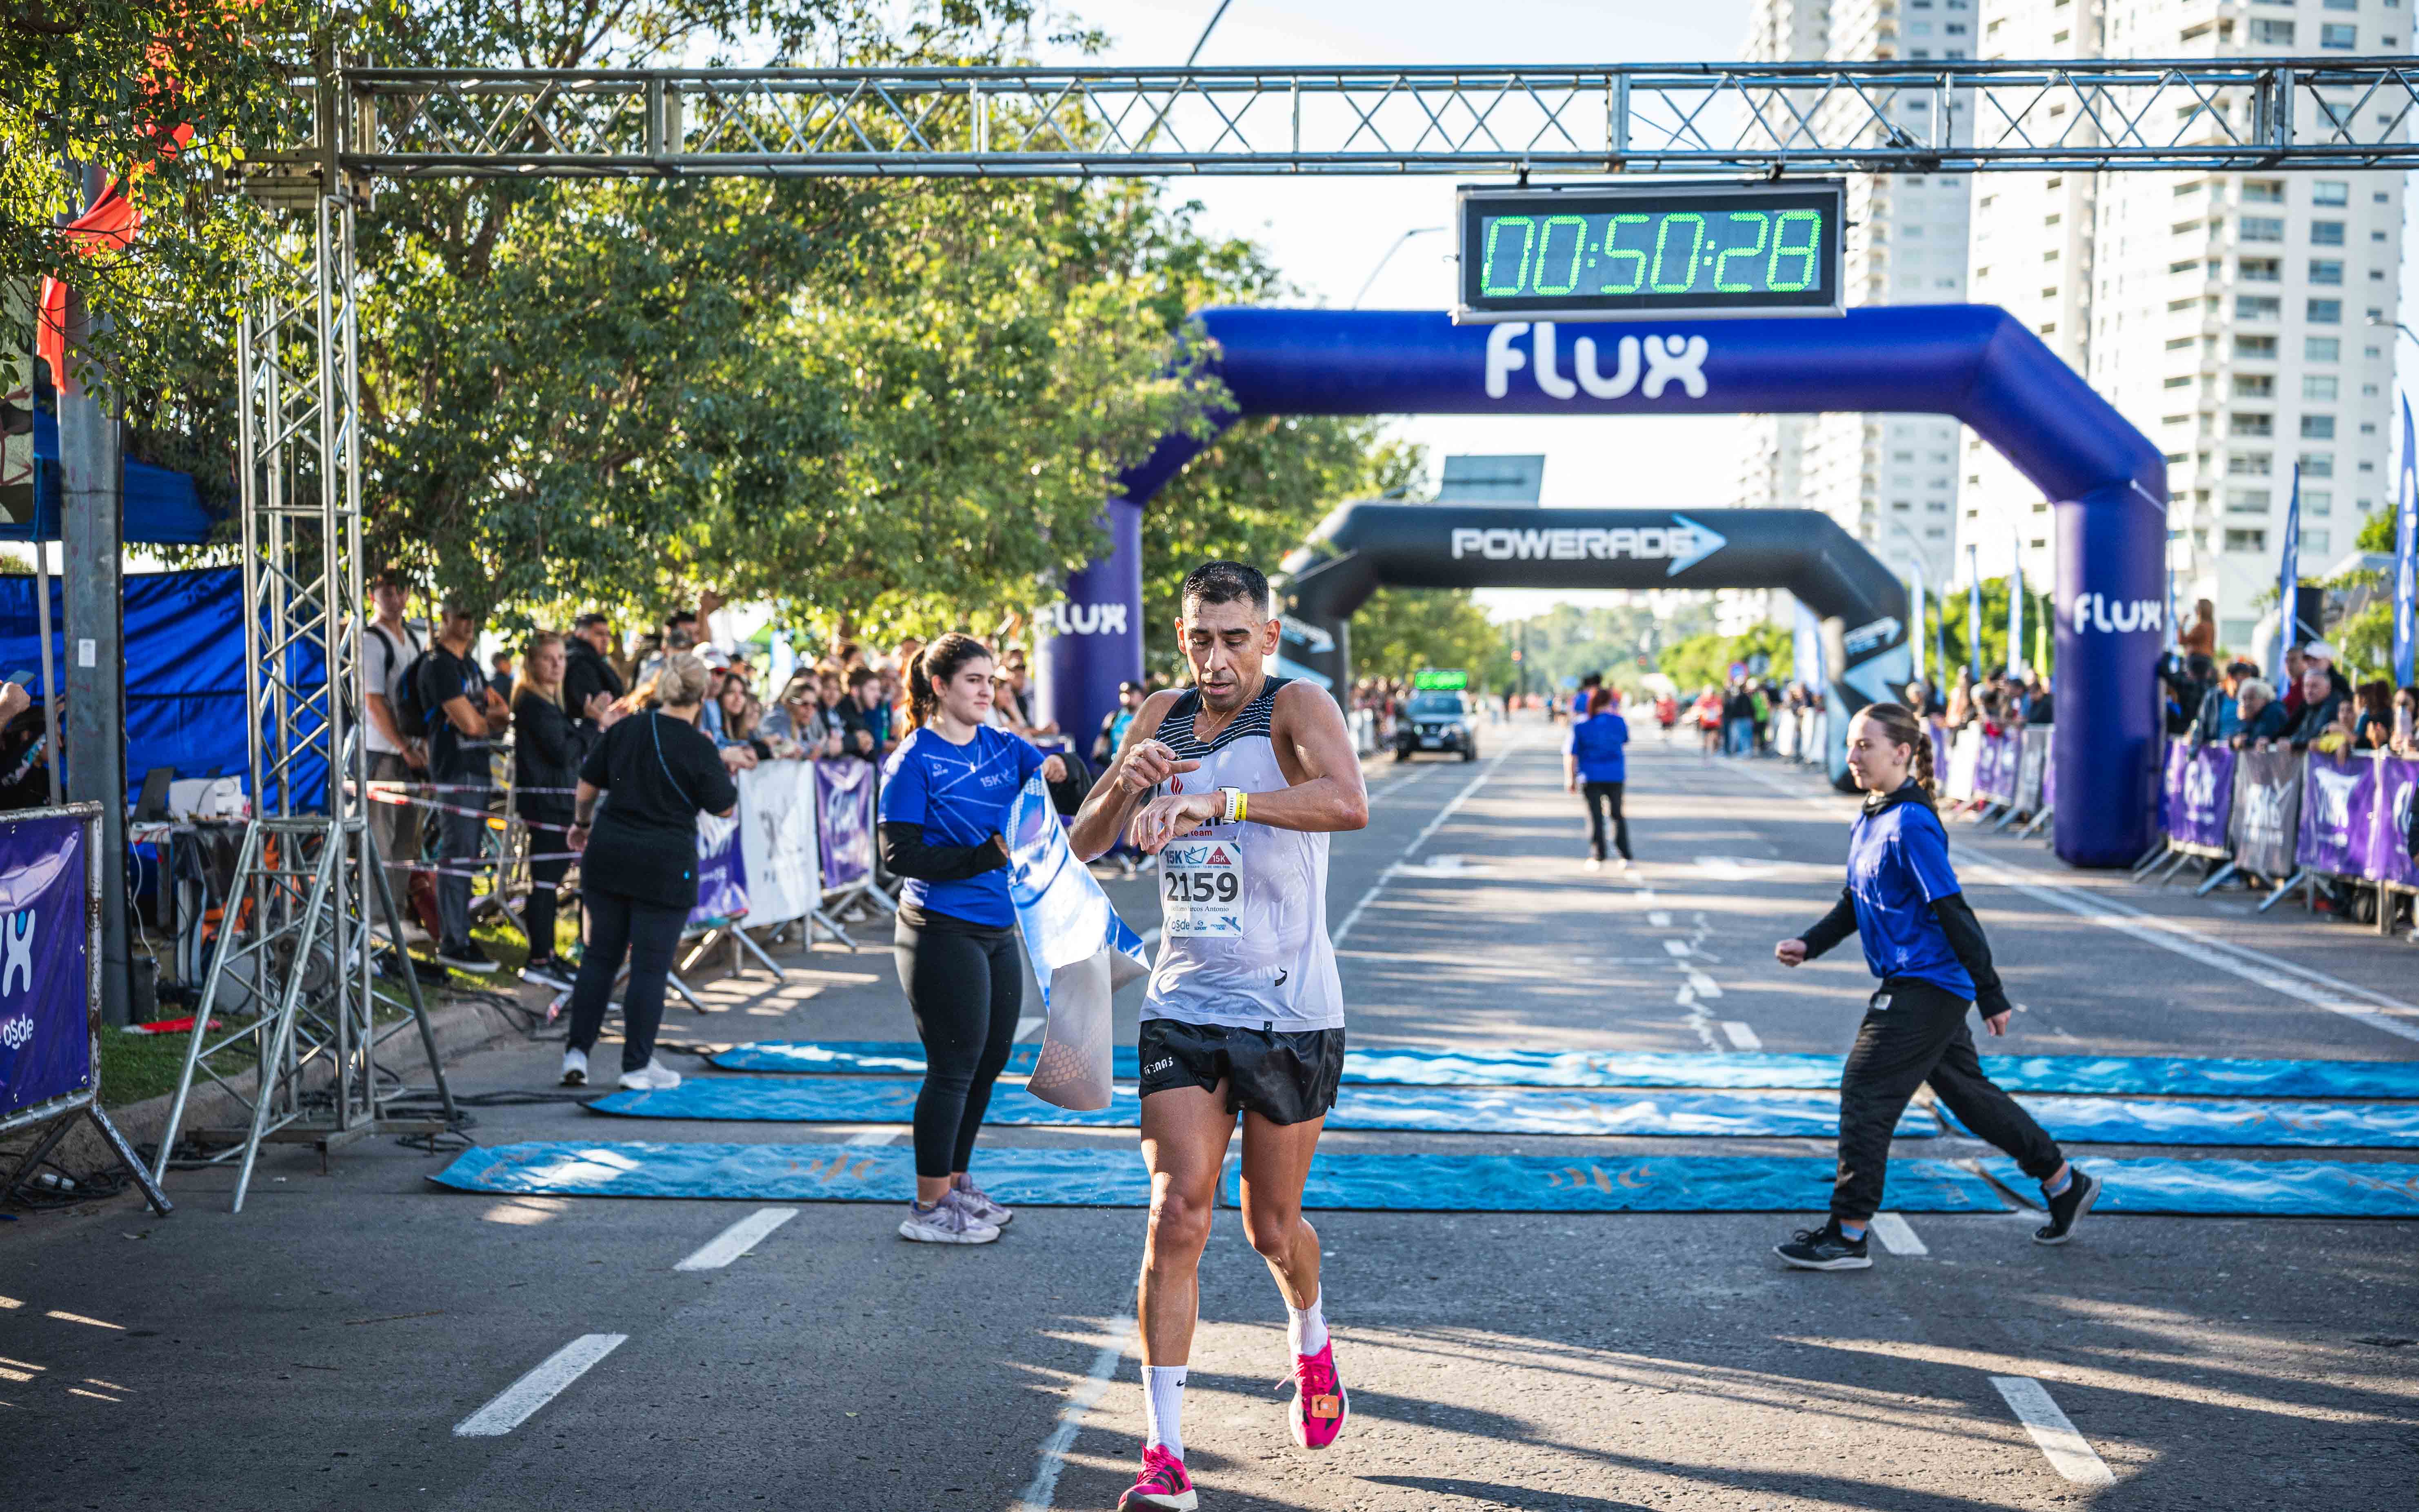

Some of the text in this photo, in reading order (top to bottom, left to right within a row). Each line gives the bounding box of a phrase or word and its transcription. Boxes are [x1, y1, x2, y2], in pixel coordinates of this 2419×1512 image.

[1480, 210, 1822, 296] 00:50:28
[1451, 527, 1697, 560] POWERADE
[1165, 850, 1182, 864] 15K
[1165, 872, 1238, 902] 2159
[3, 1012, 34, 1050] osde
